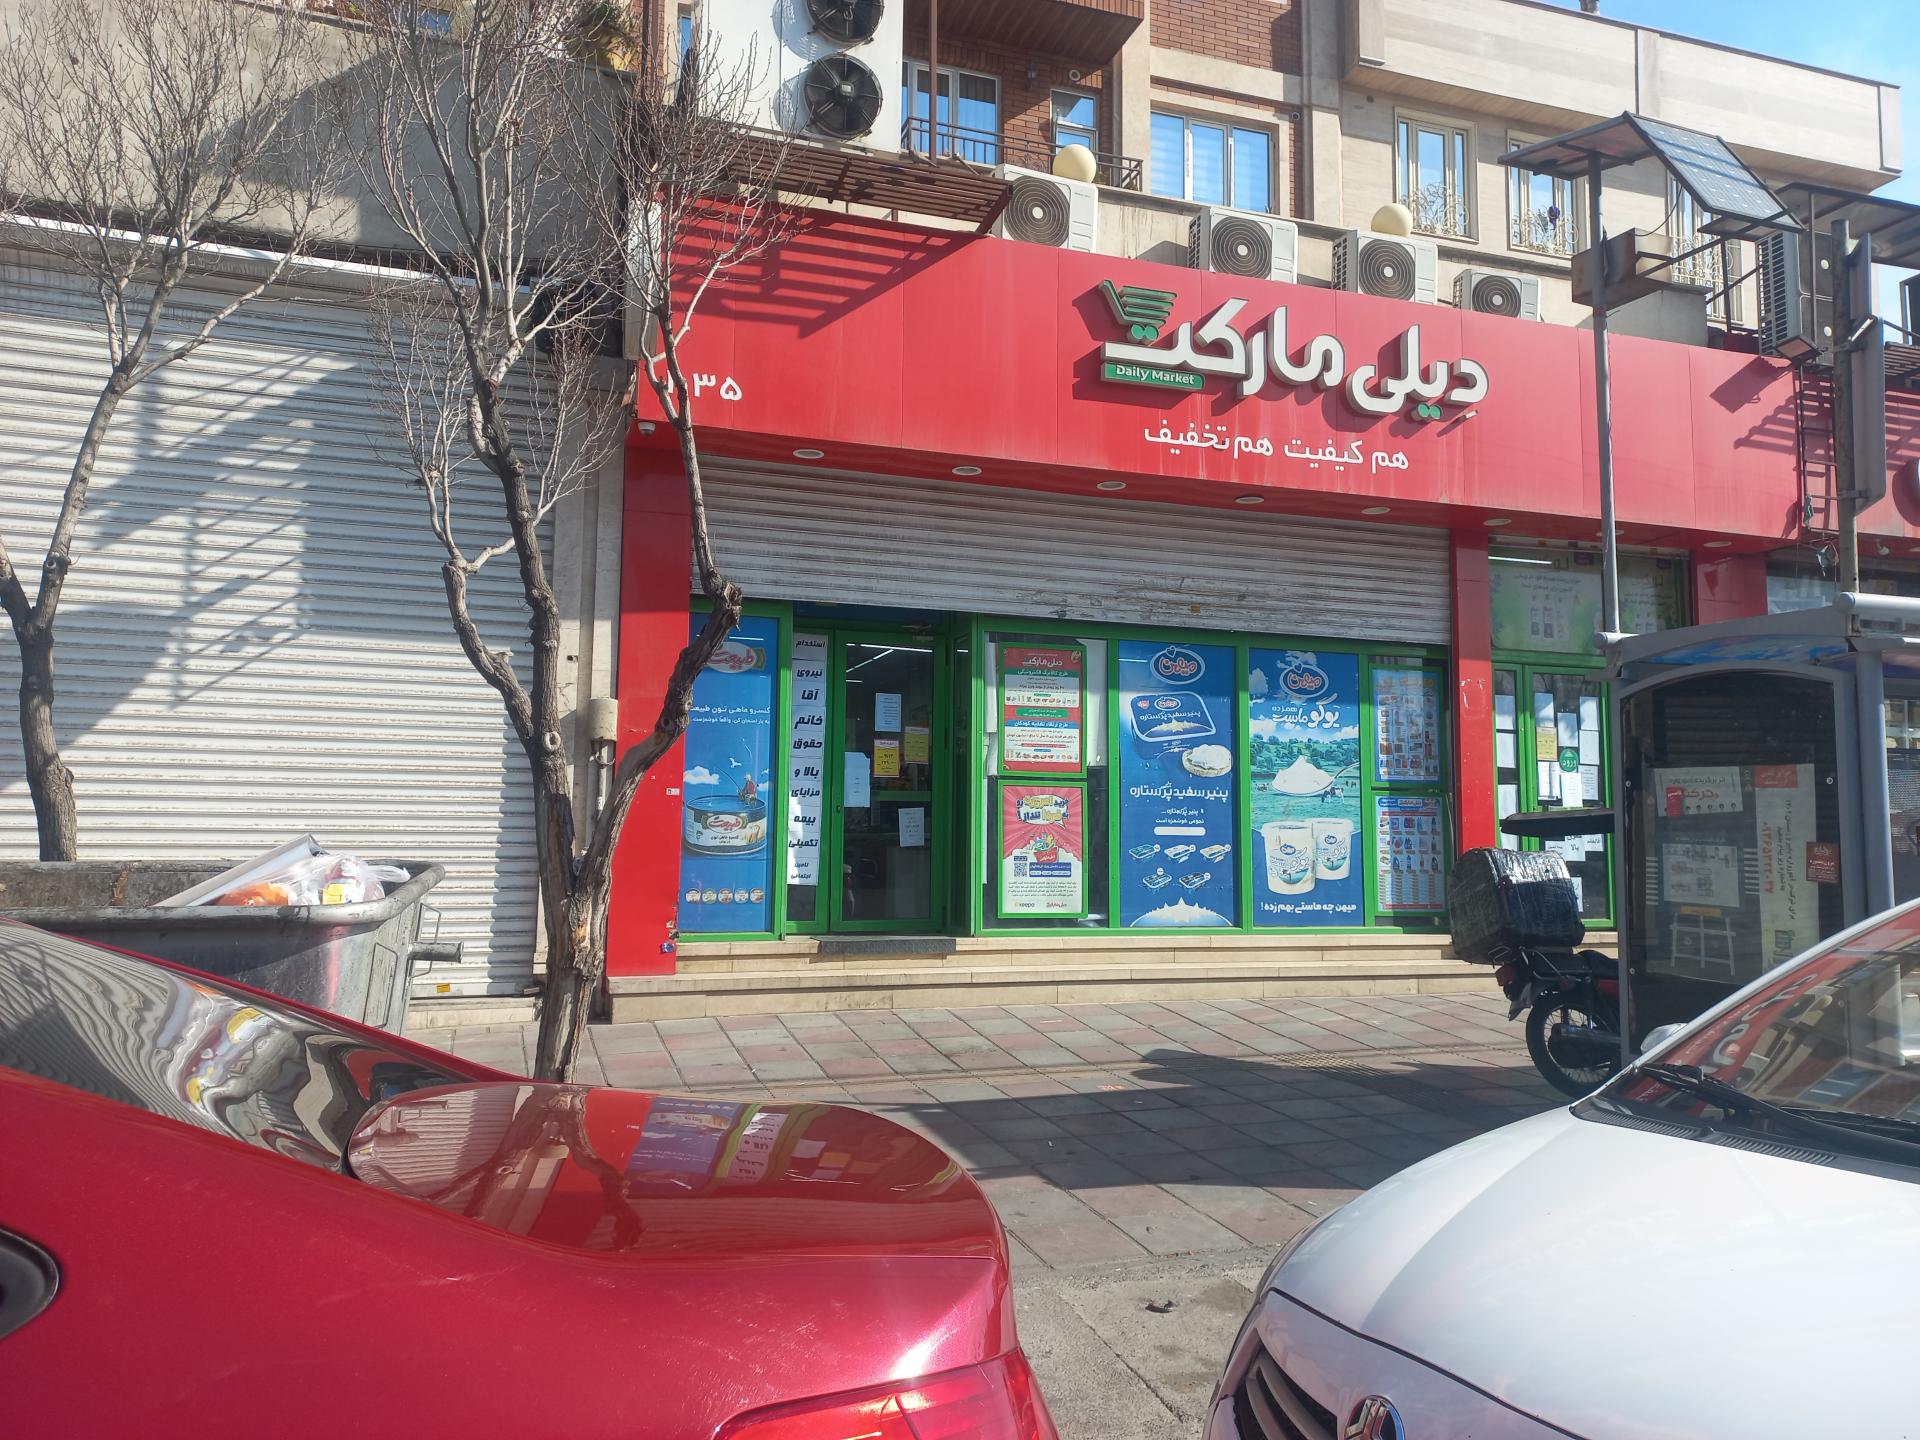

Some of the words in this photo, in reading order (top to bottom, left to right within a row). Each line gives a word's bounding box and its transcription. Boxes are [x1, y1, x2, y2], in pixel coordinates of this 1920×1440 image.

[1104, 297, 1345, 396] مارکت
[1116, 365, 1149, 382] Daily
[1151, 369, 1195, 386] Market
[1349, 324, 1490, 421] دیلی
[1144, 419, 1231, 455] تخفیف
[1233, 431, 1274, 459] هم
[1284, 439, 1364, 472] کیفیت
[1371, 448, 1409, 474] هم
[796, 640, 825, 648] استخدام
[797, 668, 822, 678] نیروی
[801, 689, 820, 700] آقا
[794, 714, 823, 730] خانم
[793, 738, 822, 750] حقوق
[794, 768, 800, 777] و
[803, 767, 819, 779] بالا
[791, 787, 820, 797] مزایای
[1173, 786, 1205, 800] سفید
[1204, 786, 1229, 803] پنیر
[794, 815, 816, 825] بیمه
[788, 838, 818, 848] تکمیلی
[1322, 904, 1335, 914] چه
[1335, 903, 1357, 912] میهن
